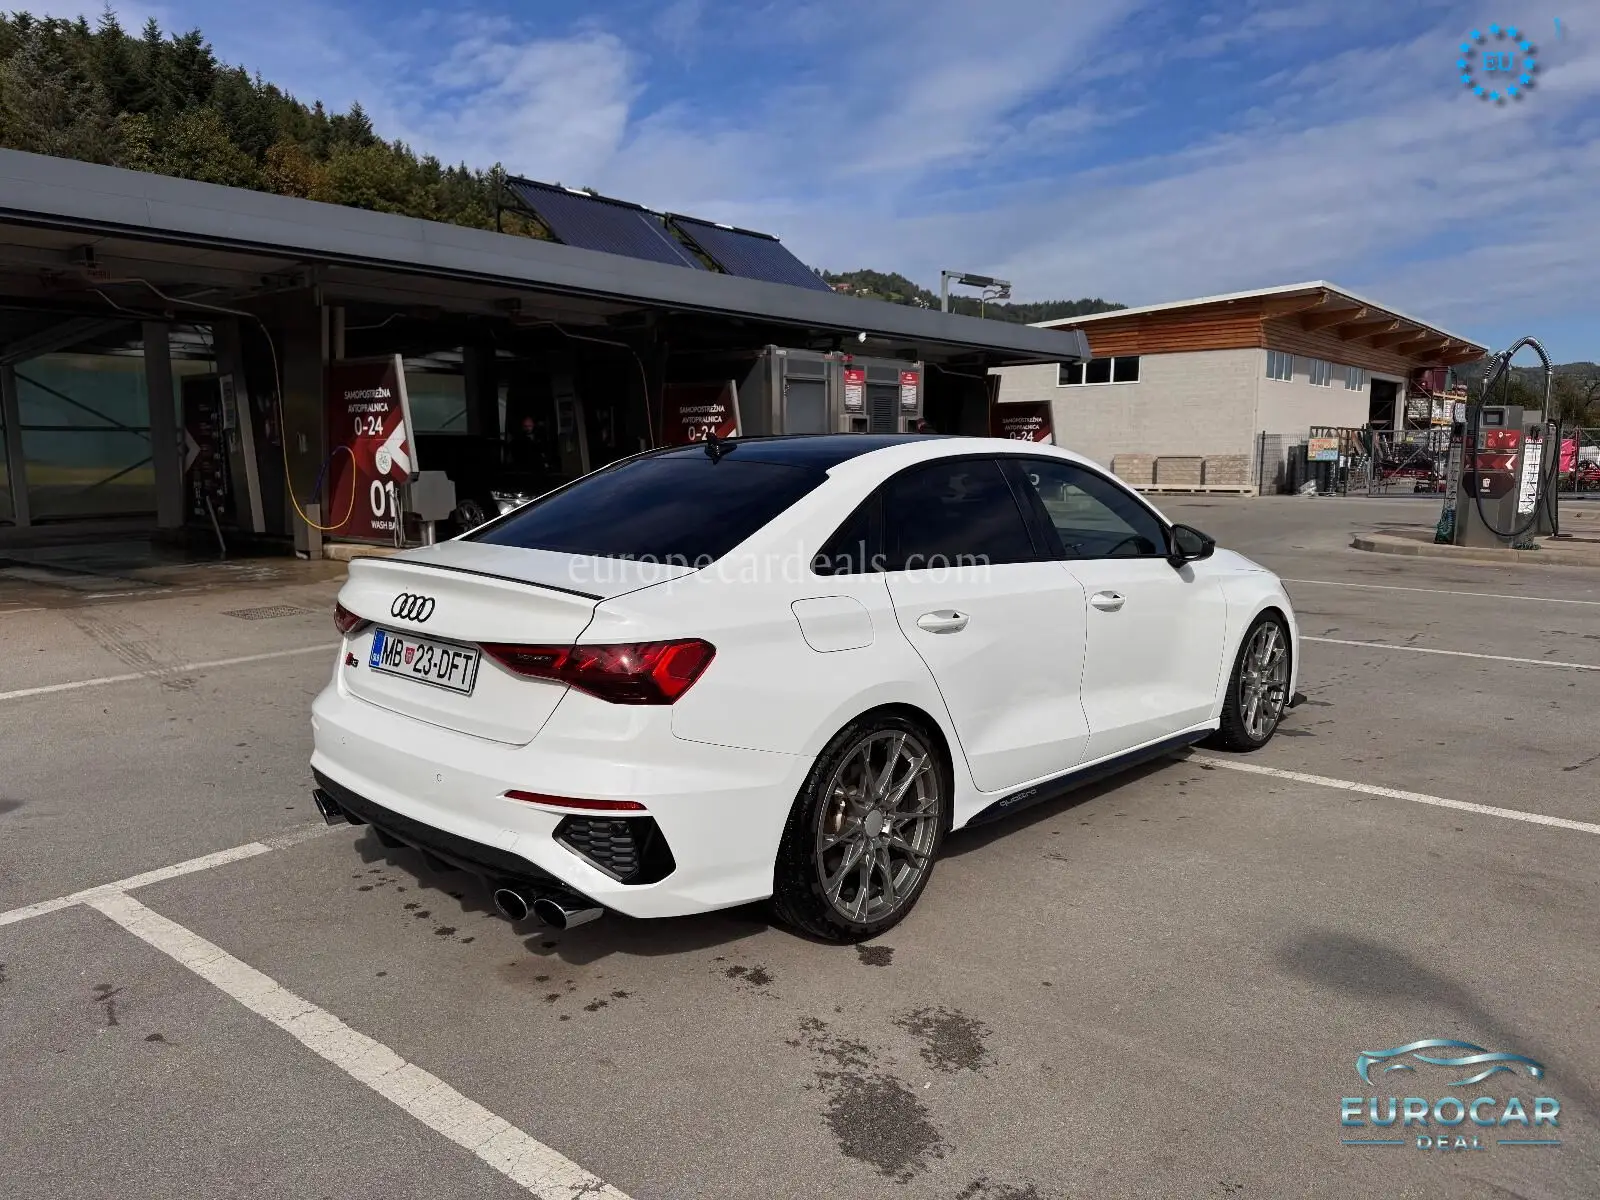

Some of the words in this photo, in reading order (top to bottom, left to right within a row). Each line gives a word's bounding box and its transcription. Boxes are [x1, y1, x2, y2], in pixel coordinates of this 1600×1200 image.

[344, 387, 391, 399] SAMOPOSTREŽNA
[348, 403, 389, 412] AVTOPRALNICA
[680, 404, 725, 413] SAMOPOSTREŽNA
[355, 416, 384, 436] 0-24
[370, 480, 396, 517] 01
[371, 520, 388, 529] WASH
[381, 637, 404, 667] MB
[413, 643, 473, 685] 23-DFT
